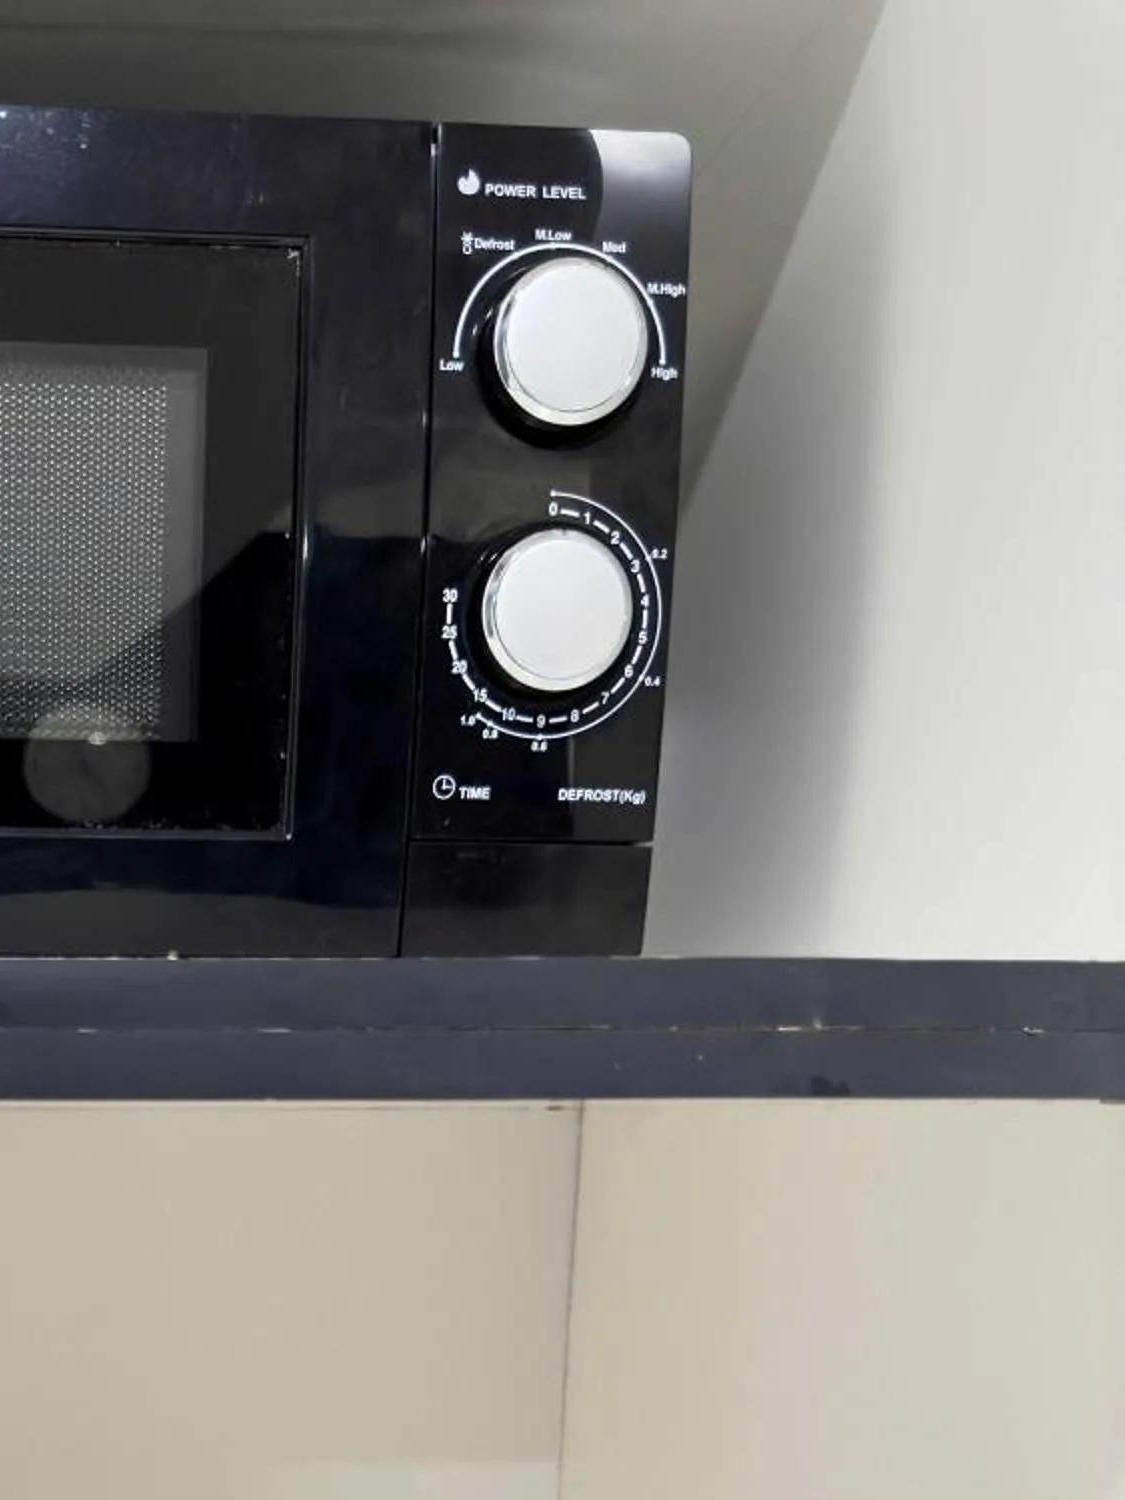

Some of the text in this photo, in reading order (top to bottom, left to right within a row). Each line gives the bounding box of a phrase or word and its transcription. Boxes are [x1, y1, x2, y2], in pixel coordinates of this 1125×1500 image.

[485, 182, 587, 200] POWER LEVEL
[534, 228, 572, 241] M.Low
[474, 237, 516, 251] Defrost
[602, 241, 627, 253] Med
[647, 282, 686, 297] M.High
[439, 359, 465, 372] Low
[651, 367, 678, 380] High
[548, 502, 559, 516] 0
[583, 511, 592, 525] 1
[610, 531, 621, 545] 2
[630, 559, 641, 573] 3
[442, 588, 459, 602] 30
[640, 593, 650, 608] 4
[441, 625, 458, 639] 25
[638, 630, 648, 645] 5
[451, 659, 468, 675] 20
[623, 666, 634, 679] 6
[474, 687, 488, 703] 15
[600, 691, 611, 705] 7
[501, 706, 516, 721] 10
[570, 709, 580, 723] 8
[536, 713, 546, 729] 9
[459, 786, 491, 799] TIME
[558, 787, 647, 805] DEFROST(Kg)
